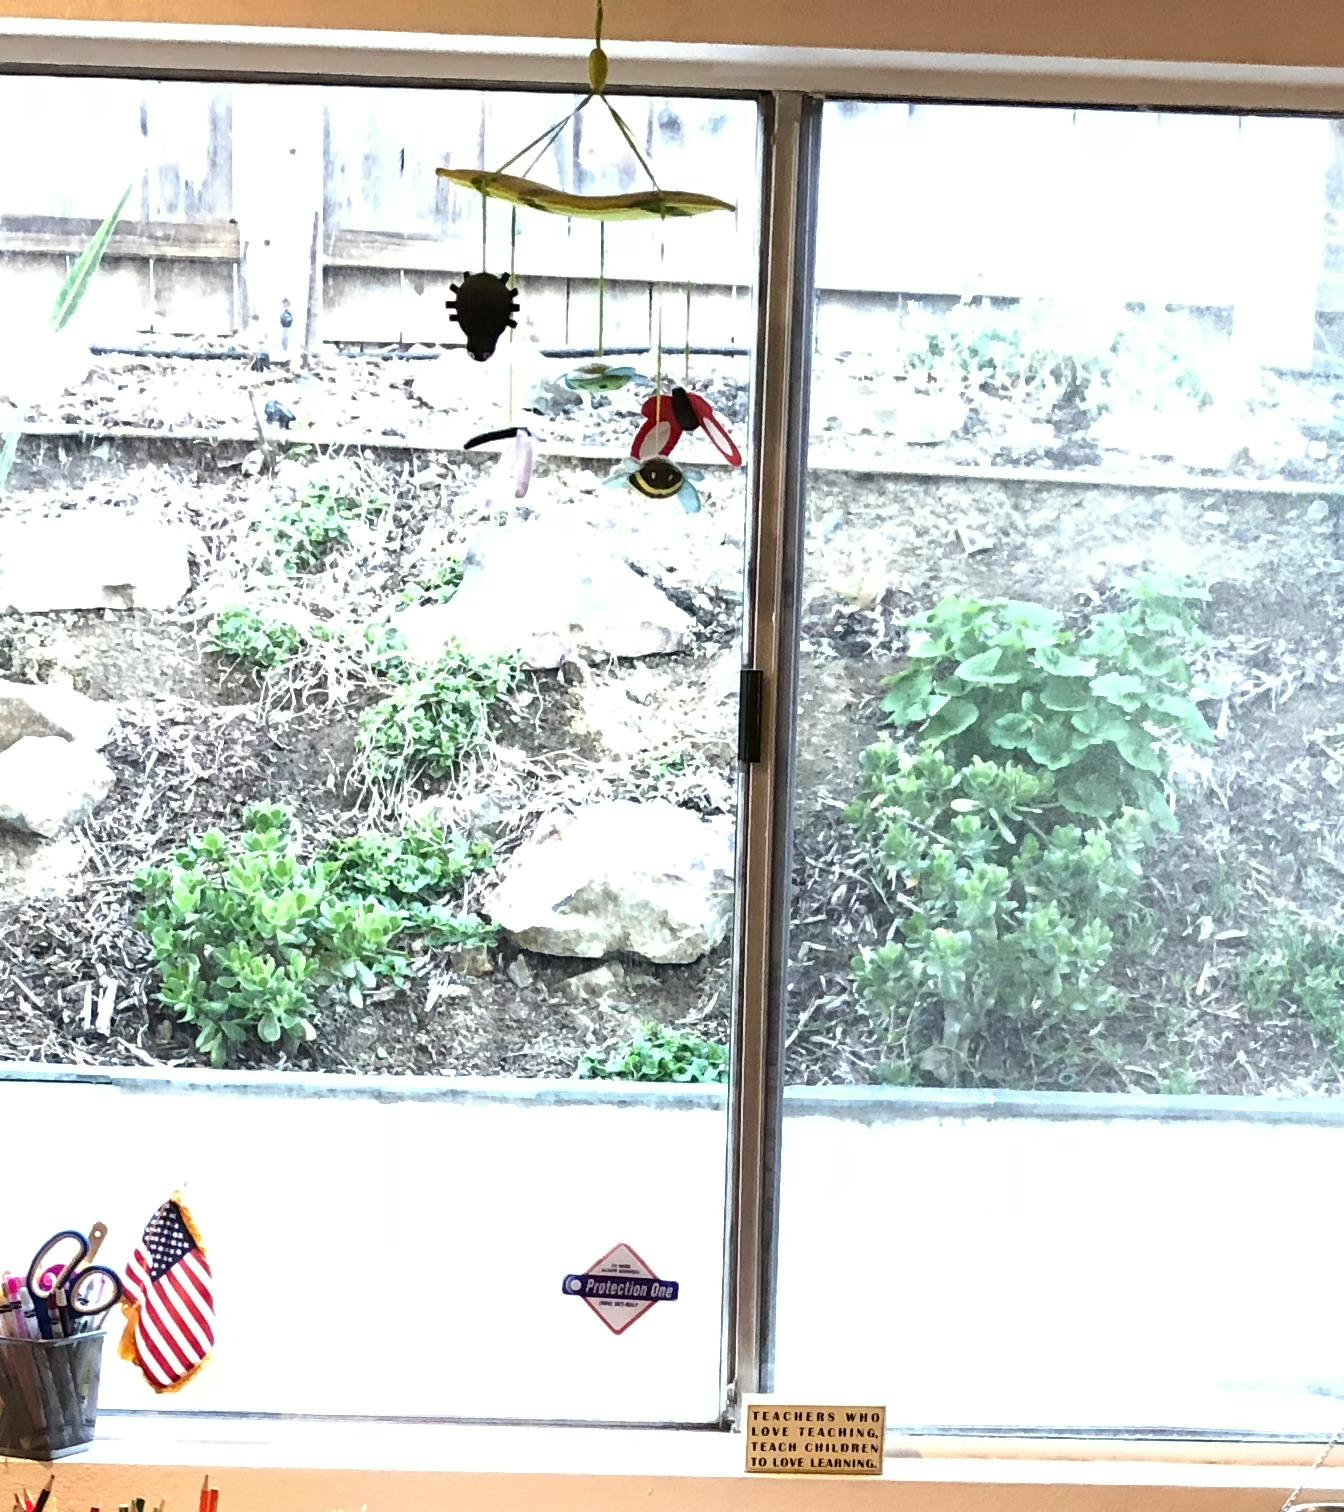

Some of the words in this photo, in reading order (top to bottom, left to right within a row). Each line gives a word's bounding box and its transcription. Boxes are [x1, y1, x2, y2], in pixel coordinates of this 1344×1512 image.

[585, 1278, 647, 1297] Protection
[650, 1282, 674, 1298] One
[752, 1410, 836, 1422] TEACHERS
[845, 1412, 880, 1423] WHO
[751, 1426, 789, 1437] LOVE
[798, 1427, 879, 1439] TEACHING,
[751, 1441, 797, 1452] TEACH
[804, 1442, 879, 1453] CHILDREN
[750, 1456, 768, 1467] TO
[772, 1457, 804, 1467] LOVE
[810, 1457, 877, 1469] LEARNING.
